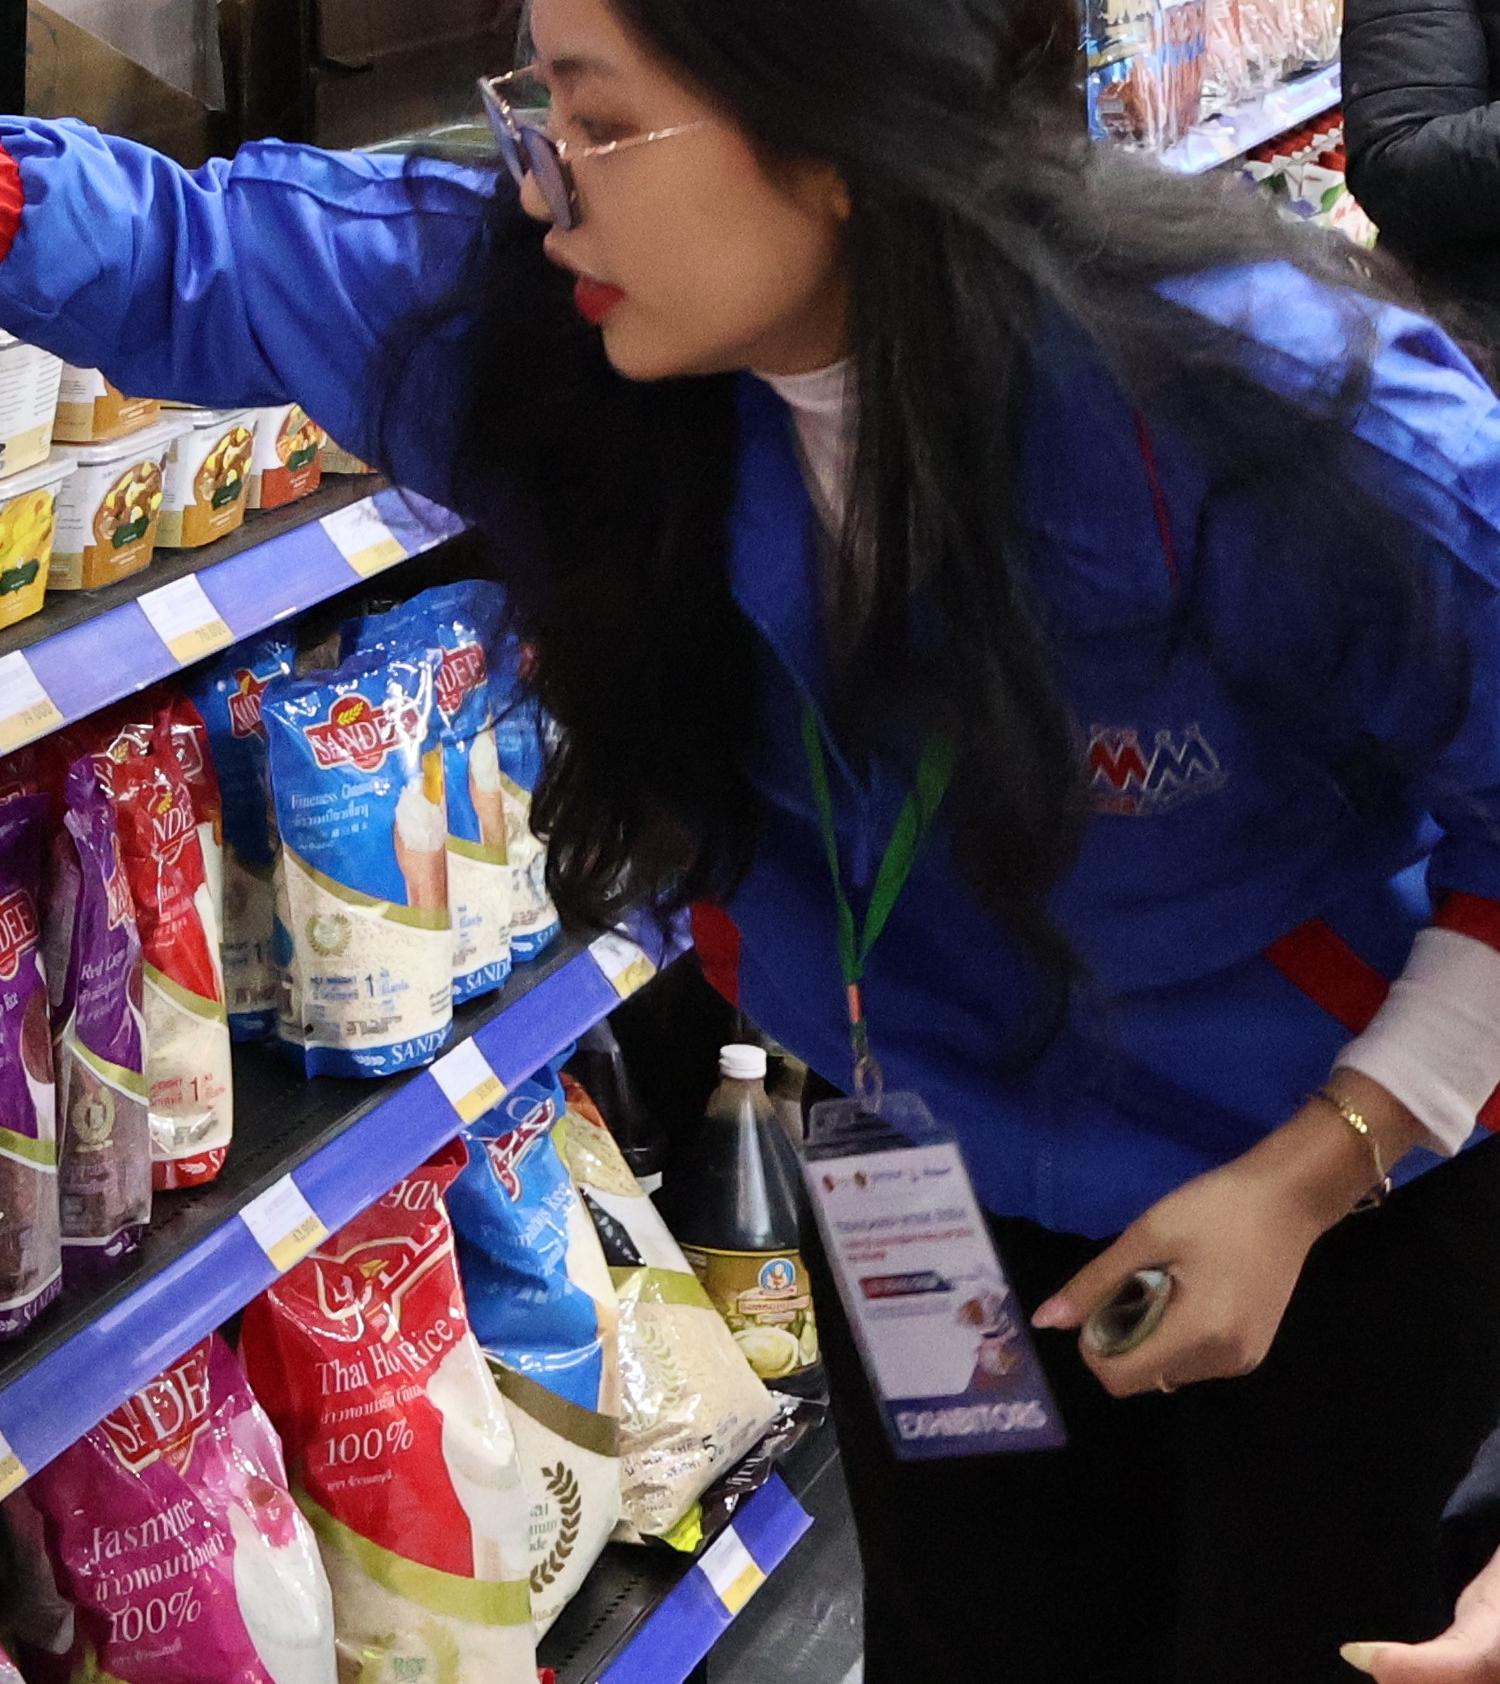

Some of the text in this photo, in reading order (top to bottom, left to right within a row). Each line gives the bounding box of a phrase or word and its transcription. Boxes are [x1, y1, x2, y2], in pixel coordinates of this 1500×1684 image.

[314, 1316, 456, 1397] Thai Rice
[324, 1417, 415, 1468] 100%
[90, 1495, 197, 1565] Jasmine
[109, 1584, 202, 1645] 100%
